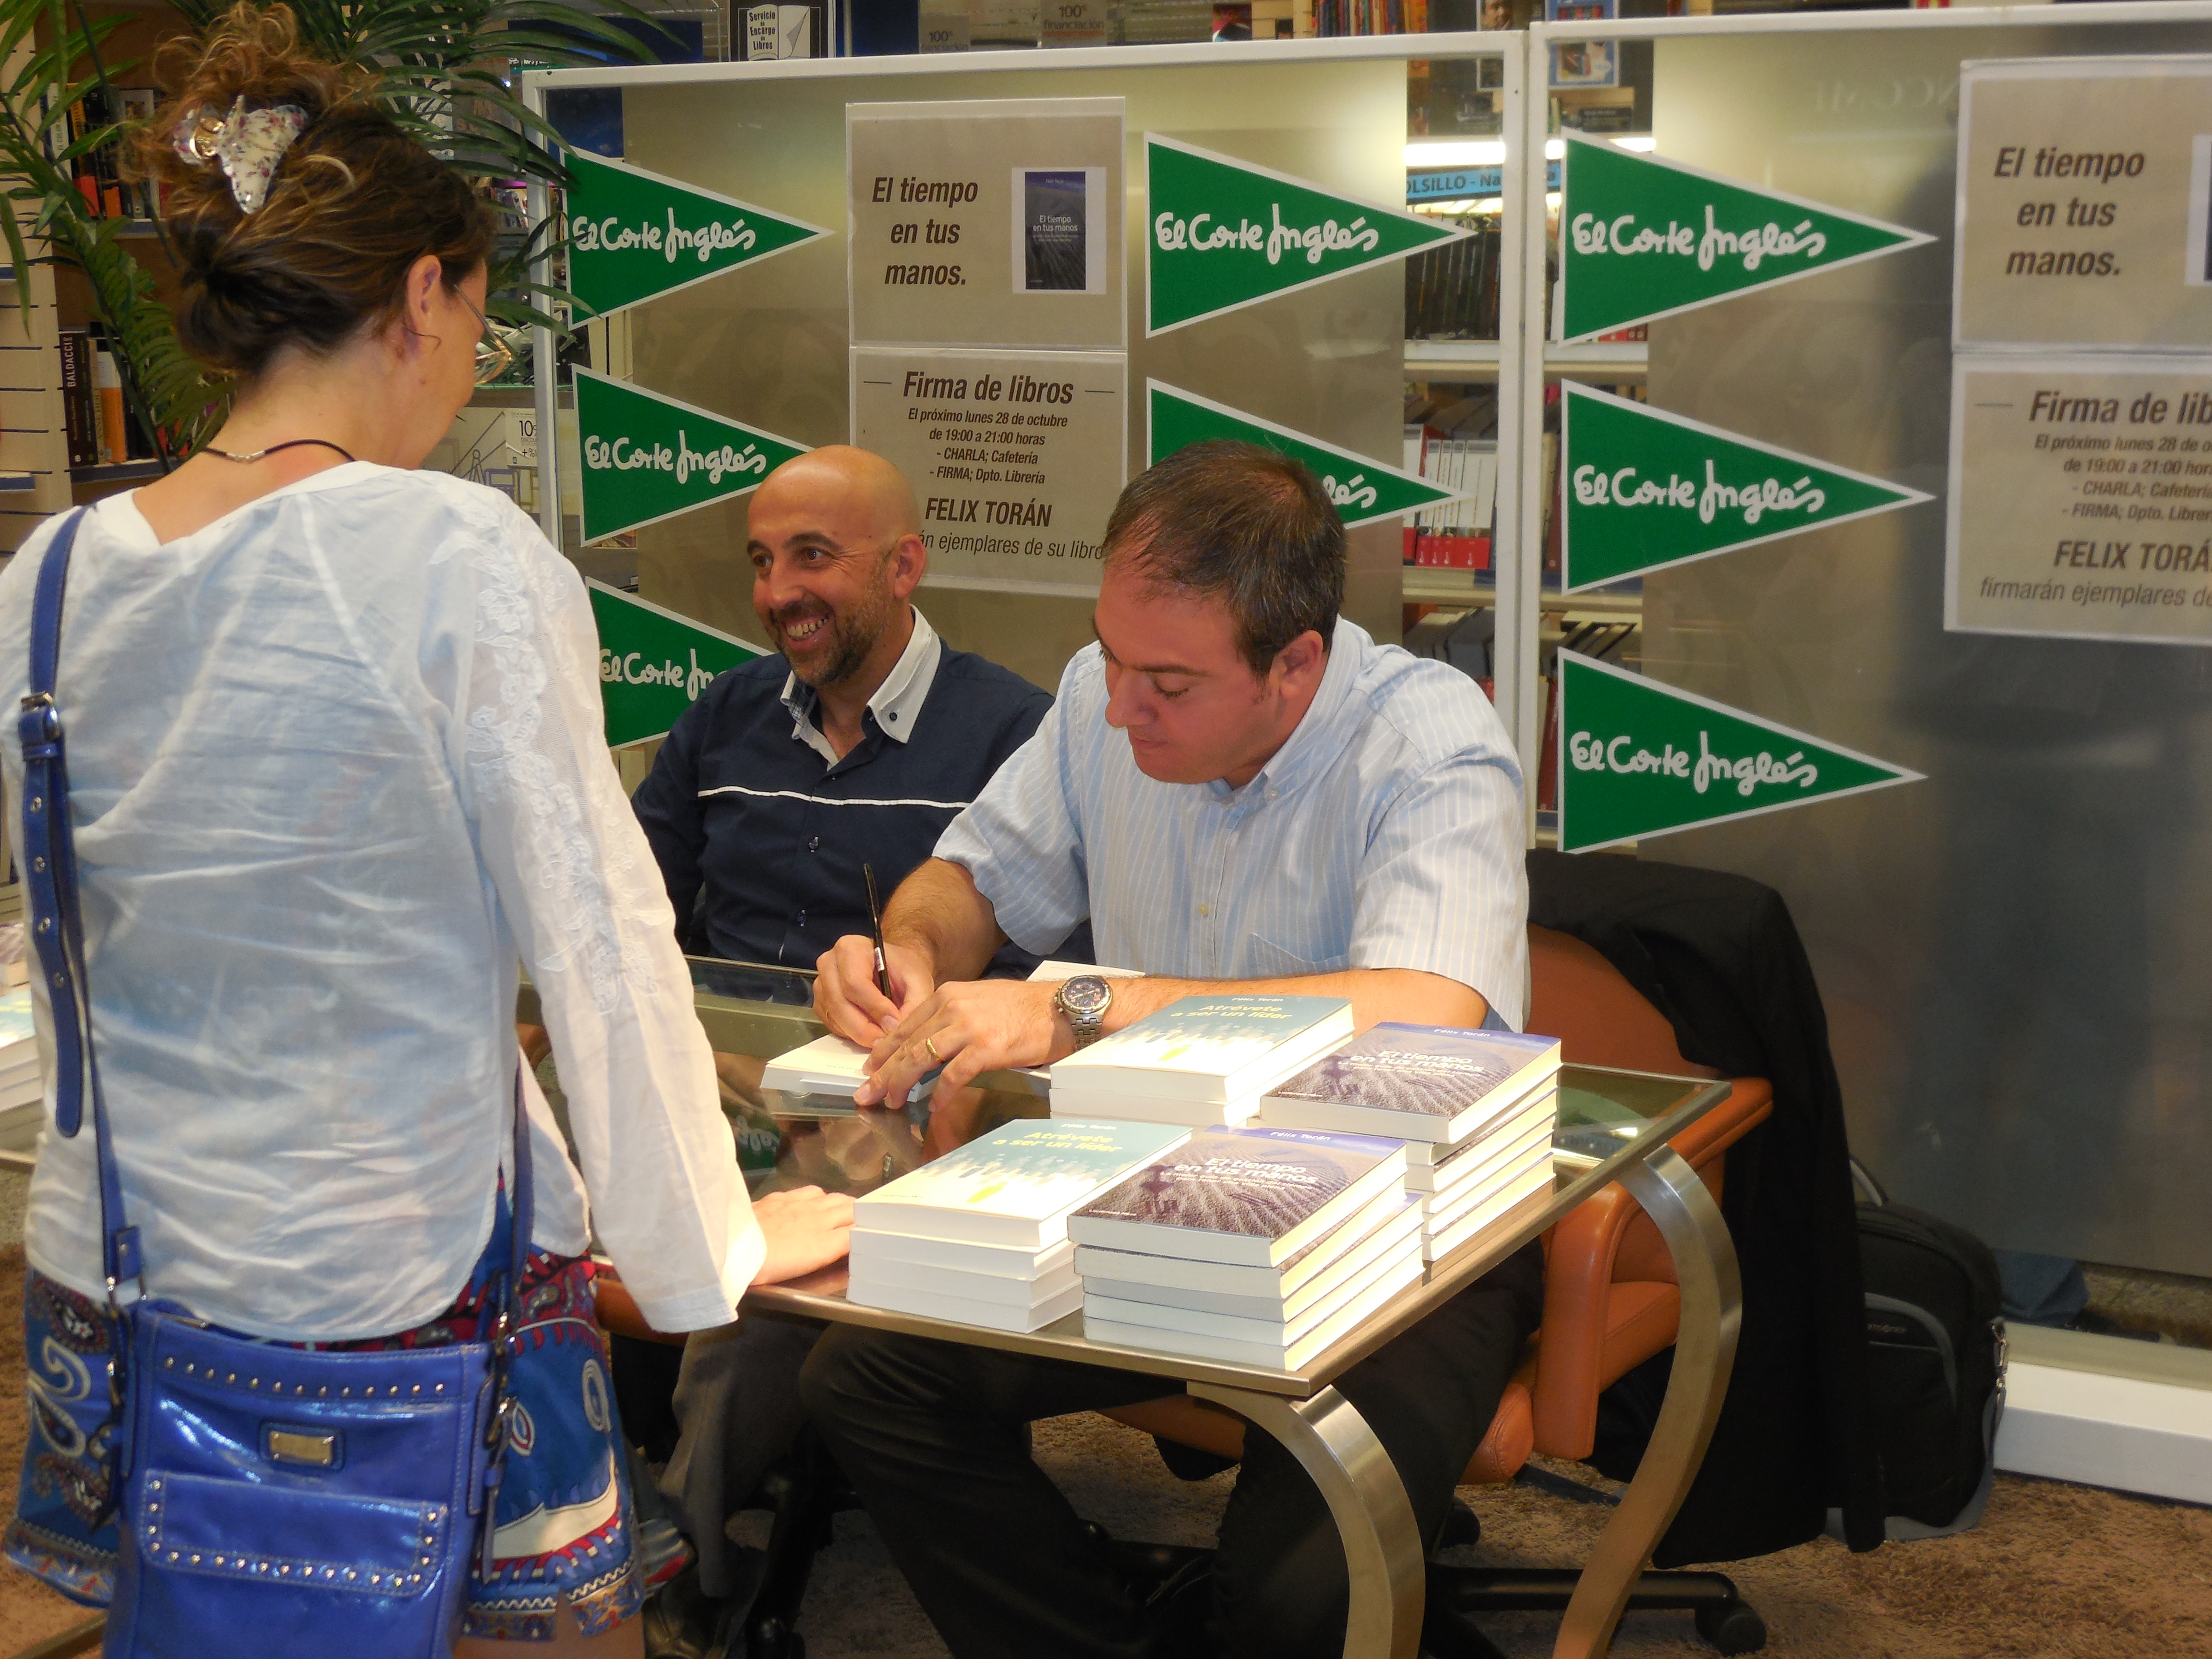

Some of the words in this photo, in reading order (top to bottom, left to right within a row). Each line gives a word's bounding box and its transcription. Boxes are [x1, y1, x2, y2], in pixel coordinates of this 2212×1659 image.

[749, 11, 775, 22] Servicio
[750, 26, 775, 36] Encargo
[753, 41, 773, 50] Libros
[1995, 147, 2024, 178] El
[2033, 147, 2145, 184] tiempo
[872, 177, 894, 203] El
[900, 178, 978, 208] tiempo
[1048, 215, 1071, 224] tiempo
[2017, 202, 2054, 227] en
[2066, 197, 2117, 227] tus
[601, 217, 661, 251] Corte
[665, 207, 756, 263] Inglés
[891, 223, 918, 244] en
[926, 219, 960, 244] tus
[1155, 212, 1187, 251] El
[1190, 214, 1263, 251] Corte
[1267, 203, 1379, 265] Inglés
[1572, 213, 1607, 255] El
[1610, 215, 1694, 256] Corte
[1698, 204, 1826, 272] Inglés
[2006, 250, 2120, 276] manos.
[885, 264, 966, 286] manos.
[903, 371, 968, 399] Firma
[974, 374, 1002, 401] de
[1009, 375, 1074, 404] libros
[908, 408, 917, 420] El
[920, 408, 962, 423] próximo
[965, 410, 993, 424] lunes
[995, 411, 1009, 425] 28
[1011, 412, 1024, 425] de
[1027, 413, 1068, 427] octubre
[2029, 390, 2119, 422] Firma
[2129, 393, 2167, 423] de
[929, 429, 942, 440] de
[946, 430, 972, 441] 19:00
[984, 432, 1013, 444] 21:00
[1015, 433, 1045, 445] horas
[2035, 434, 2048, 449] El
[2052, 434, 2110, 452] próximo
[2115, 436, 2153, 451] lunes
[2158, 436, 2176, 451] 28
[2181, 436, 2199, 452] de
[585, 435, 611, 469] El
[613, 437, 674, 471] Corte
[677, 430, 767, 484] Inglés
[944, 448, 988, 463] CHARLA;
[991, 451, 1038, 464] Cafetería
[2064, 458, 2080, 472] de
[2087, 458, 2124, 473] 19:00
[2128, 463, 2137, 474] a
[2141, 459, 2182, 474] 21:00
[937, 466, 973, 482] FIRMA;
[975, 469, 1002, 483] Dpto.
[1005, 470, 1045, 484] Librería
[1574, 465, 1609, 505] El
[1612, 468, 1695, 509] Corte
[1699, 459, 1825, 525] Inglés
[2082, 481, 2145, 498] CHARLA;
[925, 497, 979, 523] FELIX
[985, 498, 1052, 527] TORÁN
[2072, 504, 2122, 520] FIRMA;
[2127, 505, 2163, 521] Dpto.
[939, 532, 1019, 555] ejemplares
[1024, 537, 1043, 555] de
[1047, 543, 1065, 558] su
[2054, 541, 2131, 568] FELIX
[2140, 538, 2212, 572] TORÁ
[1980, 577, 2064, 600] firmarán
[2072, 580, 2186, 607] ejemplares
[624, 652, 684, 687] Corte
[1570, 731, 1605, 771] El
[1607, 735, 1690, 777] Corte
[1694, 731, 1818, 796] Inglés
[1380, 1057, 1412, 1065] tus
[1415, 1061, 1485, 1072] manos
[1402, 1053, 1473, 1064] tiempo
[1023, 1132, 1114, 1143] Atrévete
[1205, 1158, 1230, 1166] El
[1231, 1160, 1307, 1174] tiempo
[1206, 1166, 1242, 1176] tus
[1244, 1170, 1319, 1183] manos
